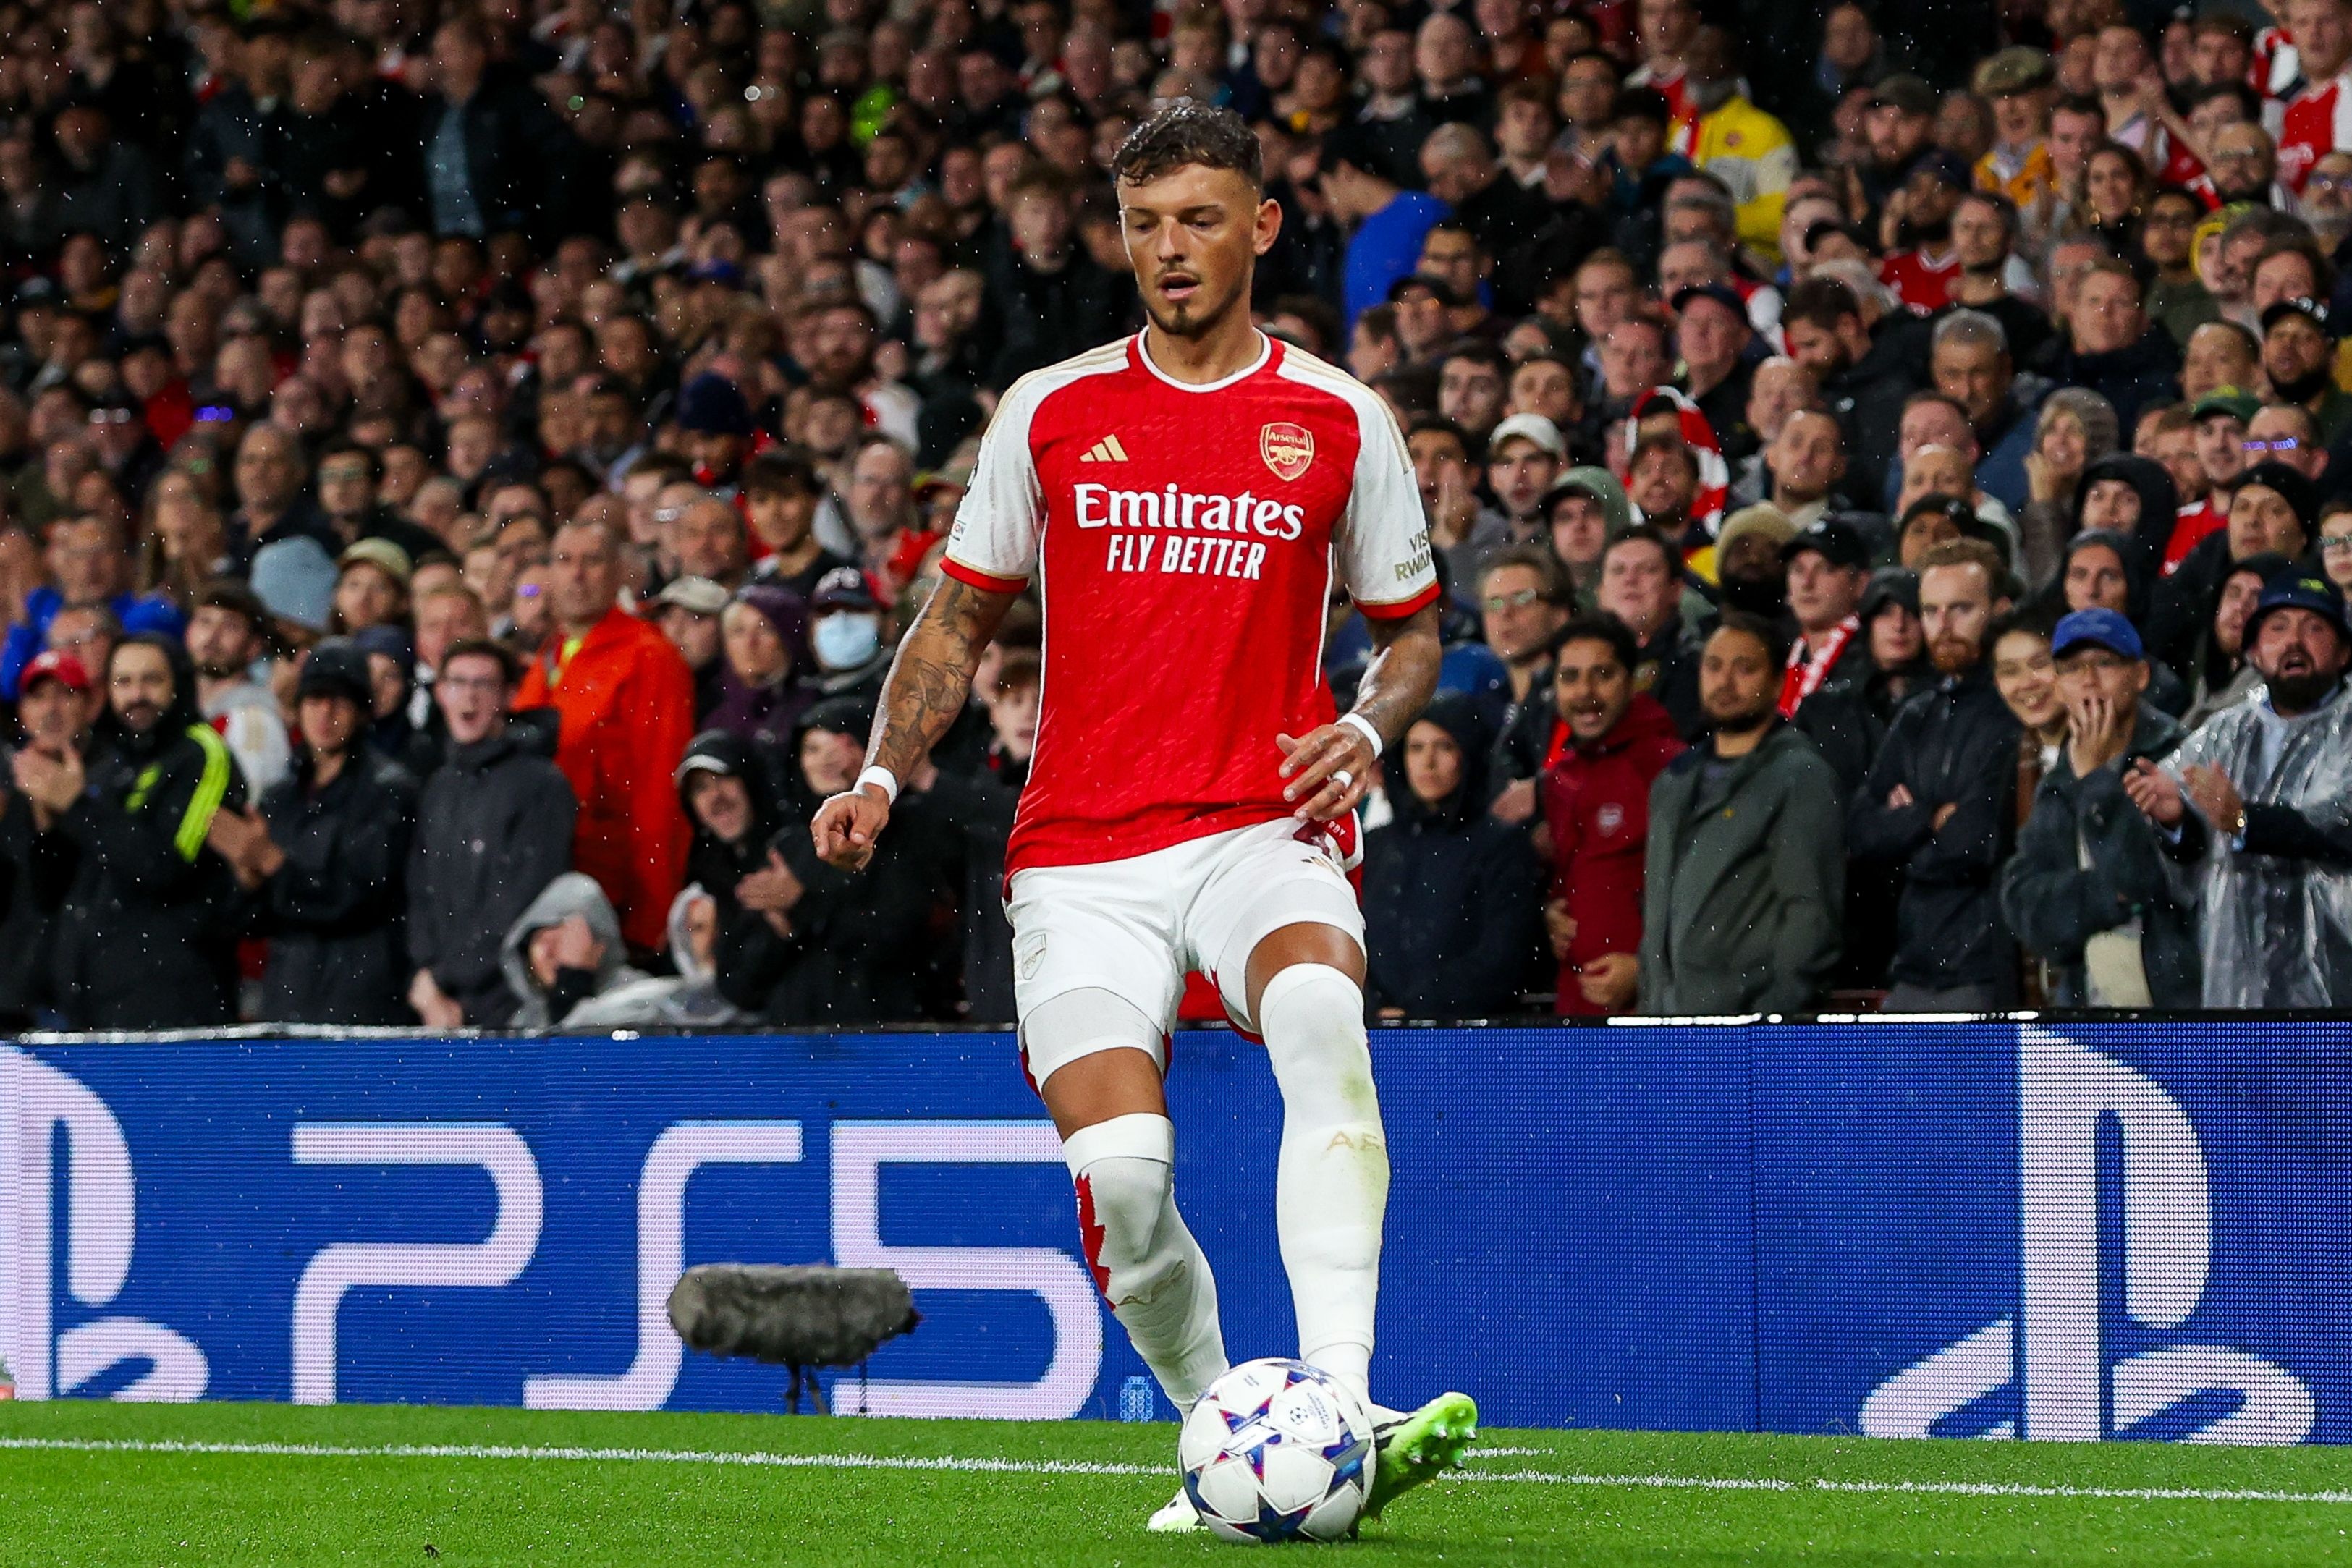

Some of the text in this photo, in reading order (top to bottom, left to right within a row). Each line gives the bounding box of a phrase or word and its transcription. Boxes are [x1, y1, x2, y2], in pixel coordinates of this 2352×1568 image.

[1073, 483, 1304, 541] Emirates
[1106, 534, 1266, 580] FLY BETTER
[292, 1119, 1102, 1422] PS5
